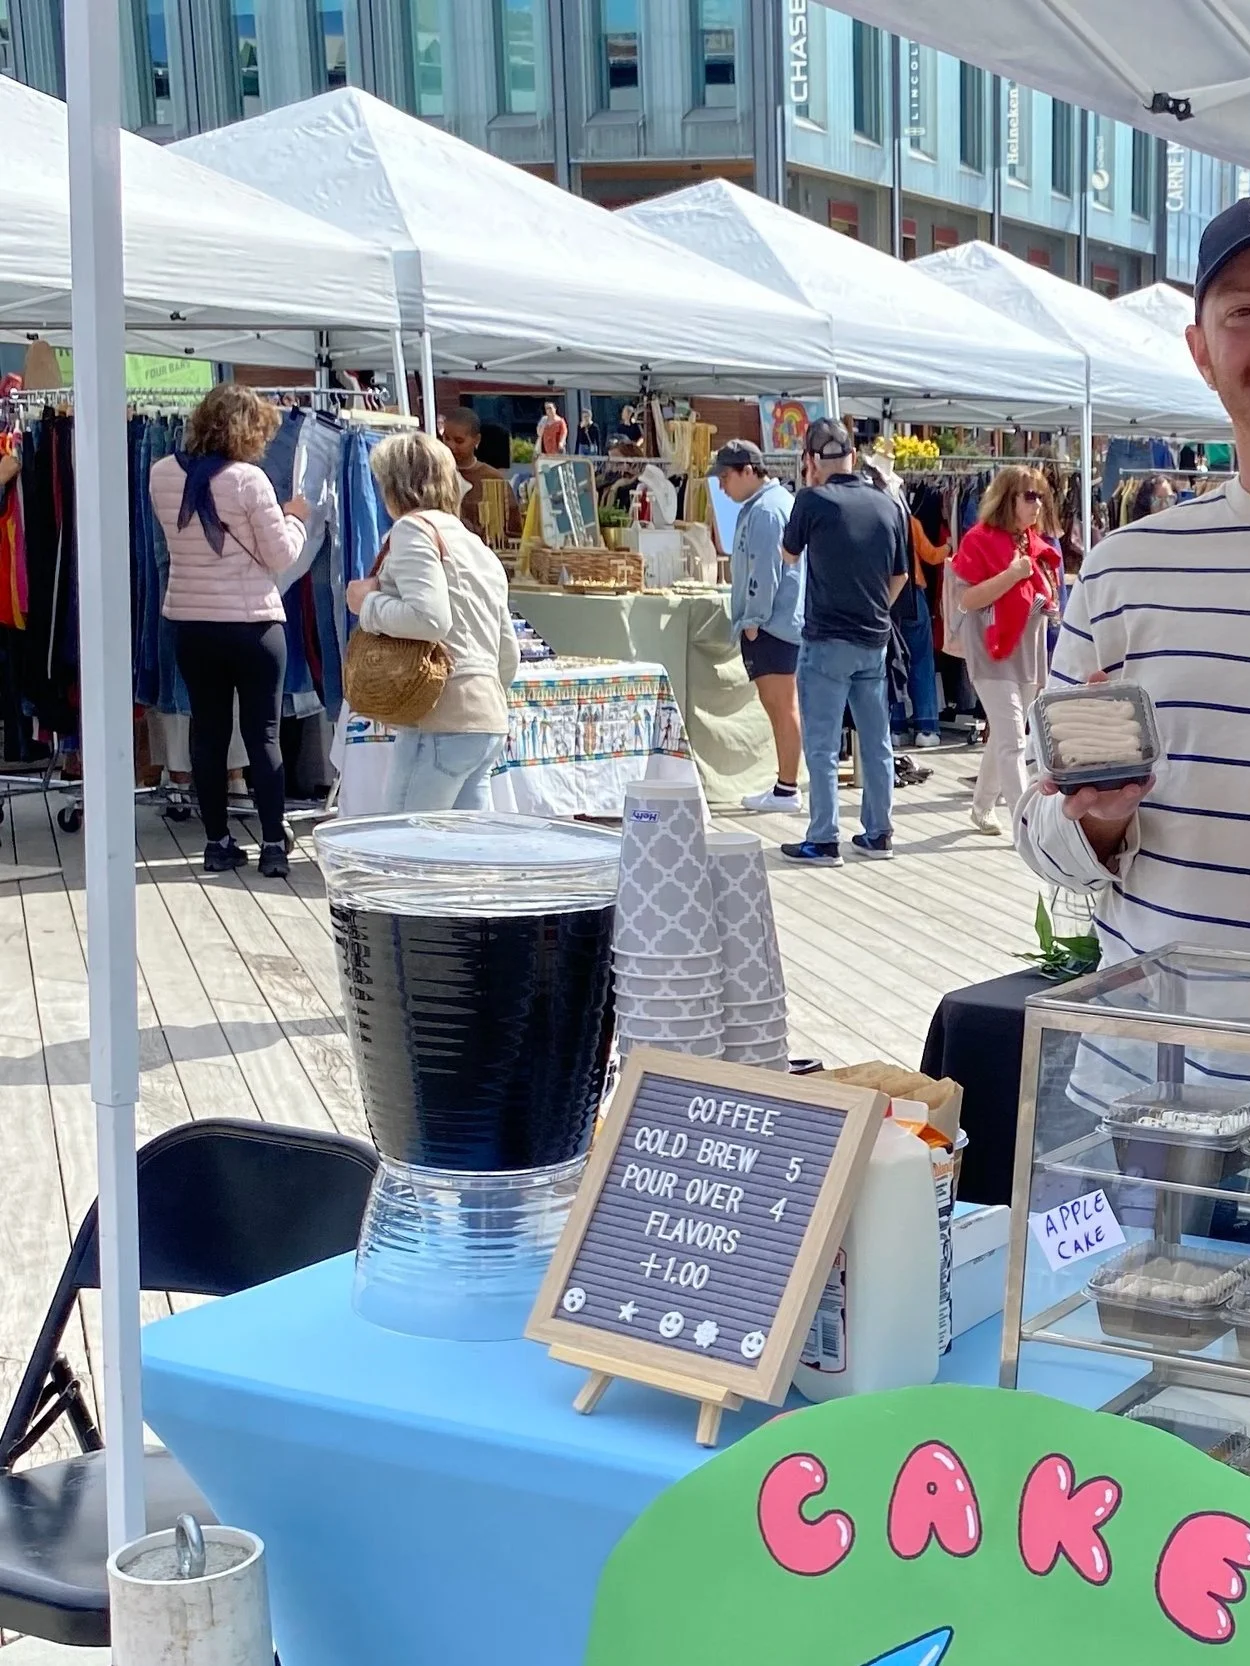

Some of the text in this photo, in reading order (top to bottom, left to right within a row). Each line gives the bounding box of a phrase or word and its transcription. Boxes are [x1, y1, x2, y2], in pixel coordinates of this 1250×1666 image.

[789, 0, 808, 103] CHASE
[1007, 87, 1019, 165] Heineken
[688, 1096, 781, 1137] COFFEE
[635, 1126, 804, 1183] COLD BREW 5
[620, 1163, 788, 1223] POUR OVER 4
[1045, 1192, 1105, 1237] APPLE
[645, 1210, 741, 1254] FLAVORS
[1057, 1226, 1106, 1260] CAKE
[640, 1252, 711, 1290] +1.00
